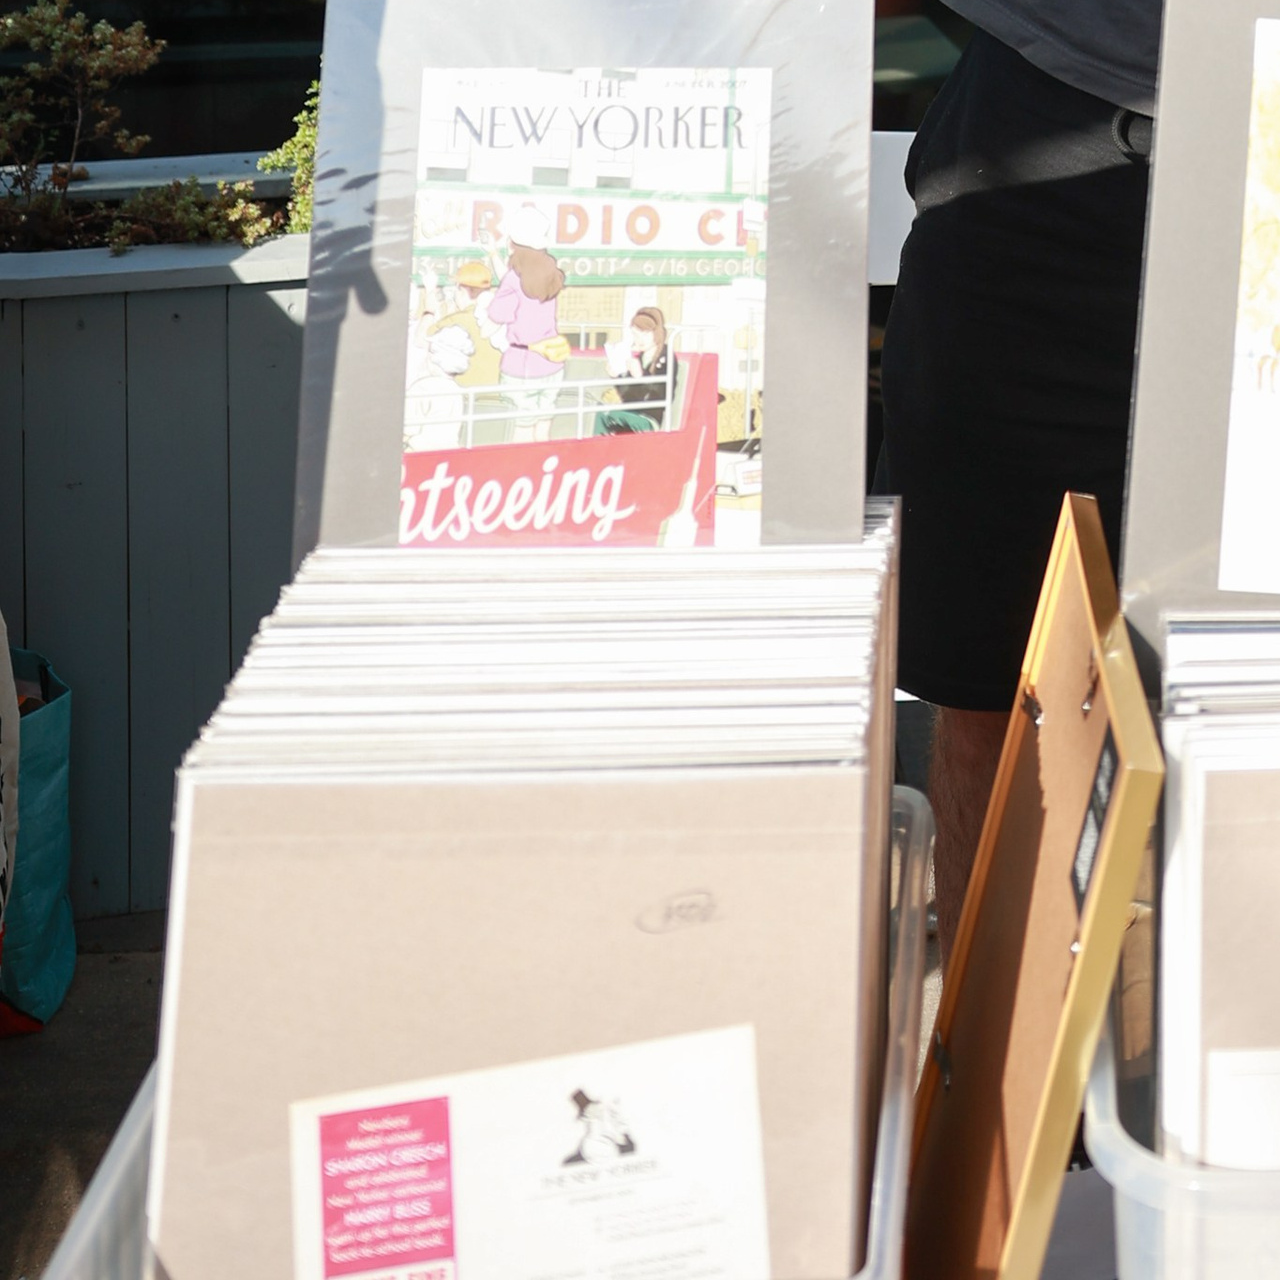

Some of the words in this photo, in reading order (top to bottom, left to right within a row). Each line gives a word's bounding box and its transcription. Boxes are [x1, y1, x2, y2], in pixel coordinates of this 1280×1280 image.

[579, 79, 628, 99] THE
[453, 104, 559, 150] NEW
[568, 103, 749, 151] YORKER
[472, 200, 661, 246] RDIO
